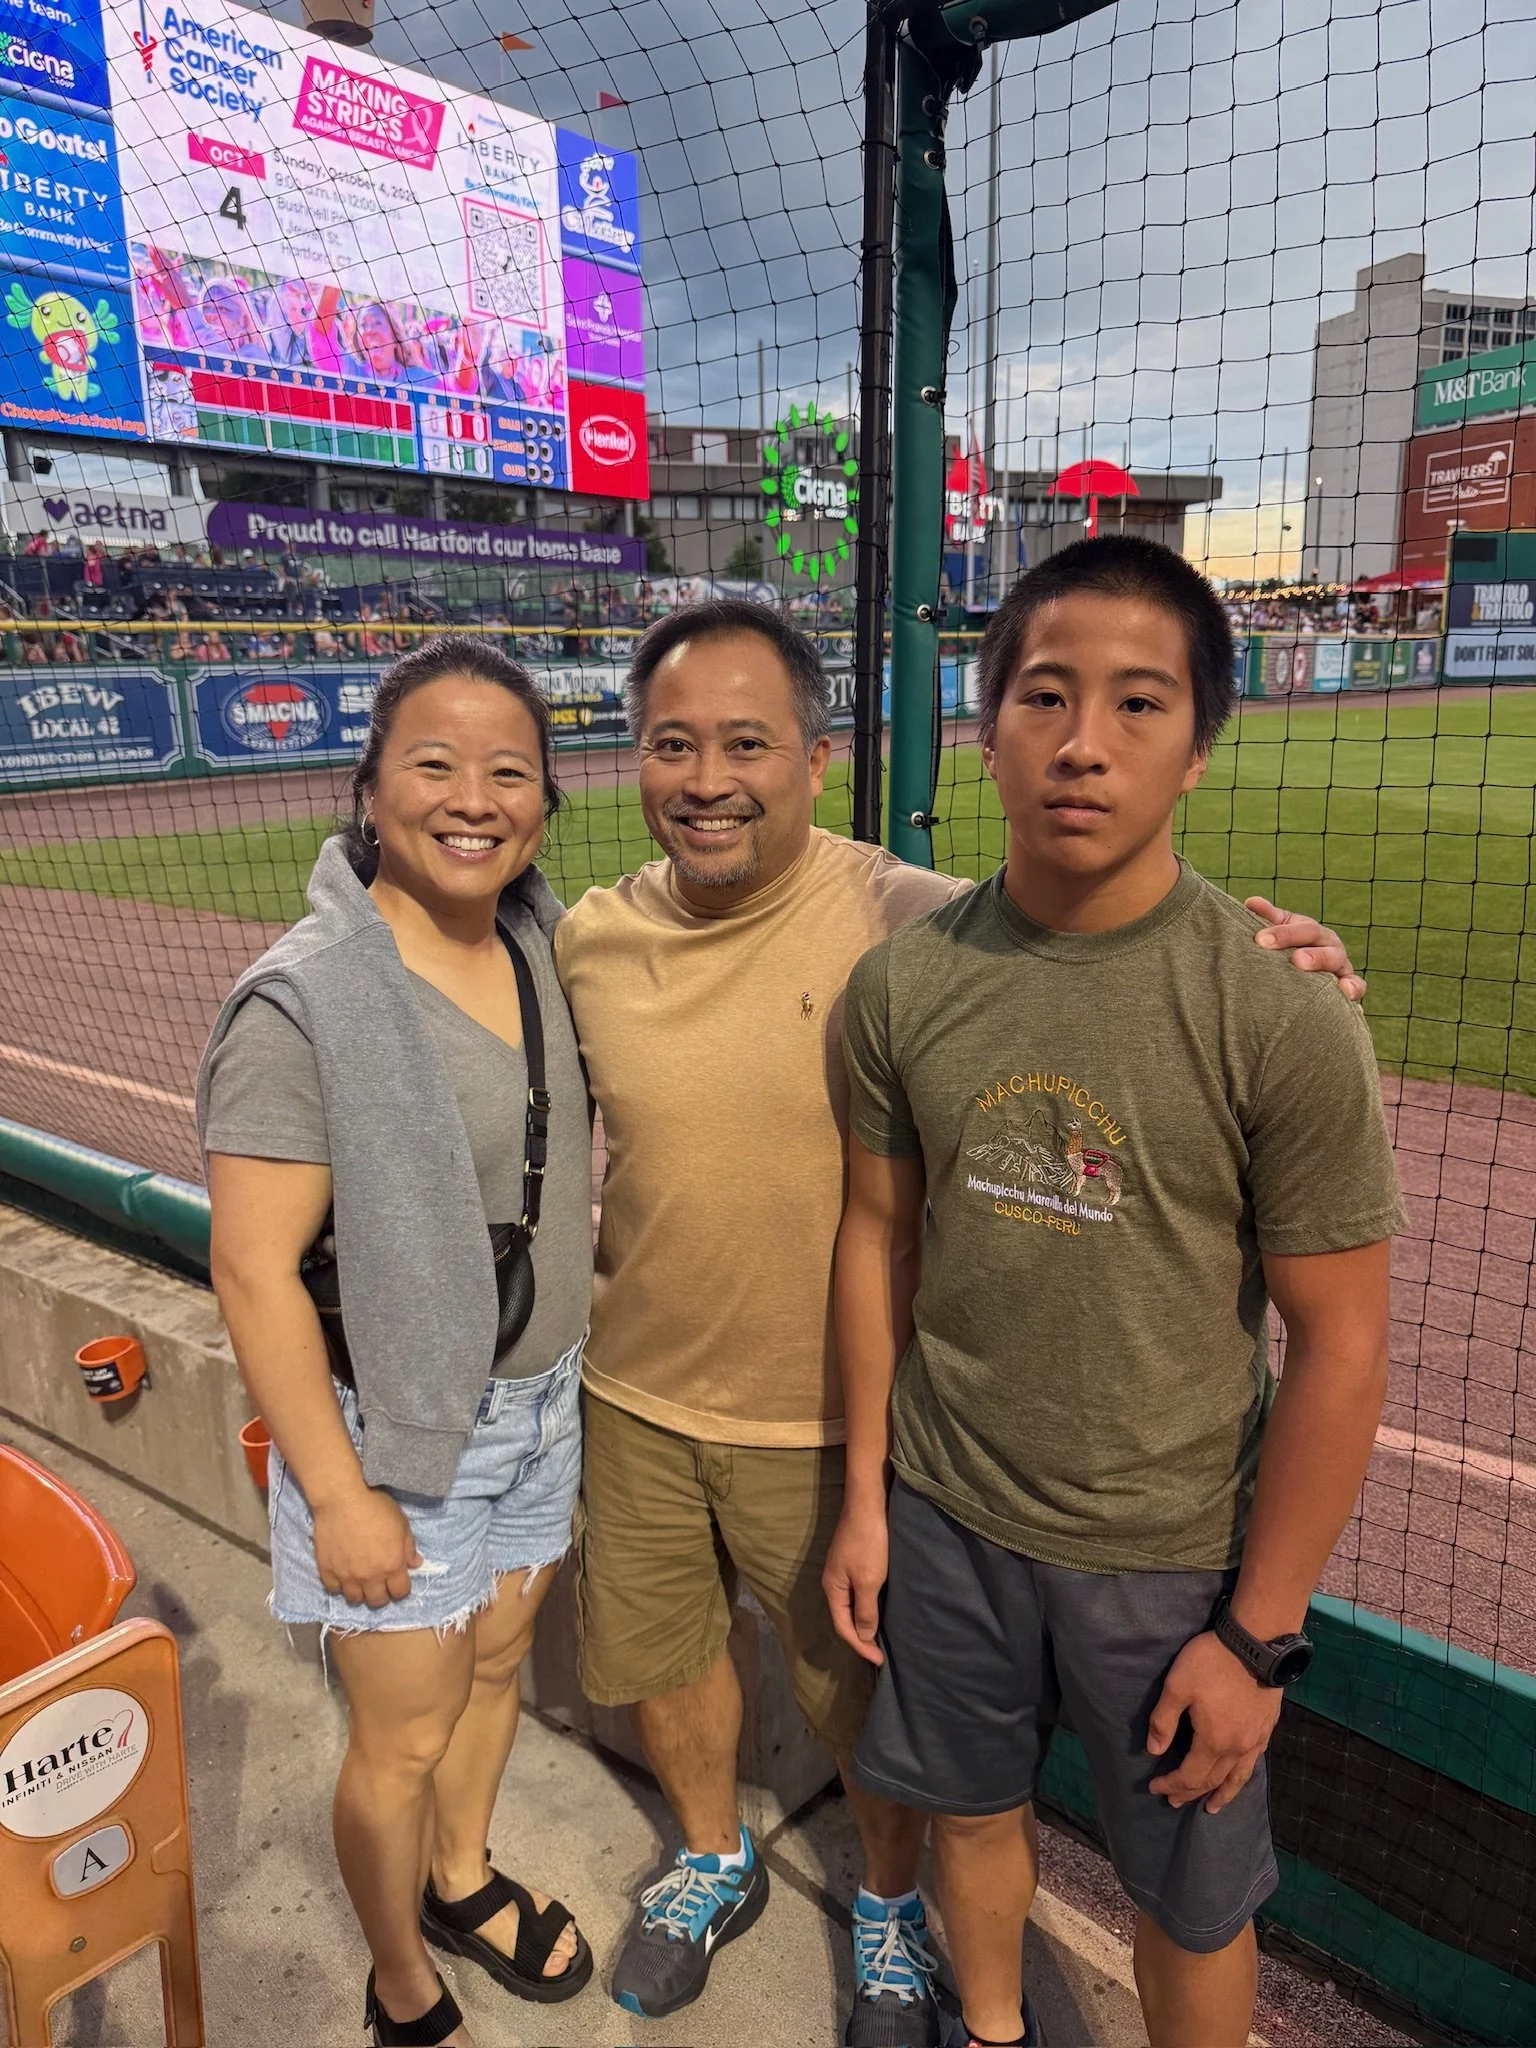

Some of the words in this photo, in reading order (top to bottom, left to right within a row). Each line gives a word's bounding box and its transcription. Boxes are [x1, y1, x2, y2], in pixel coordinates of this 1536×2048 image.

[28, 0, 78, 27] team.
[163, 6, 283, 71] American
[164, 37, 257, 89] Cancer
[312, 64, 408, 119] MAKING
[306, 91, 404, 142] STRIDES
[15, 116, 109, 164] Goats!
[210, 145, 245, 169] OCT
[273, 150, 326, 178] Sunday,
[0, 167, 108, 212] IBERTY
[219, 185, 247, 230] 4
[24, 201, 75, 226] BANK
[223, 360, 233, 374] 2
[1430, 461, 1493, 486] TRAVELERS
[74, 502, 168, 532] aetna
[248, 513, 327, 545] Proud
[328, 520, 355, 546] to
[357, 522, 400, 549] call
[401, 524, 492, 557] Hartford
[492, 536, 527, 559] our
[527, 534, 579, 563] home
[580, 538, 622, 565] base
[17, 681, 125, 719] IBEW
[232, 700, 320, 726] SMACNA
[30, 717, 95, 740] LOCAL
[97, 715, 121, 736] 42
[975, 1071, 1127, 1146] MACHUPICCHU
[967, 1174, 1025, 1202] Machupicchu
[1063, 1201, 1078, 1216] del
[1078, 1204, 1114, 1223] Mundo
[994, 1201, 1083, 1236] CUSCO-PERU
[2, 1777, 52, 1808] INFINITI
[56, 1772, 65, 1780] &
[69, 1747, 113, 1774] NISSAN
[4, 1726, 114, 1796] Harte
[56, 1771, 83, 1790] DRIVE
[84, 1757, 108, 1775] WITH
[108, 1743, 138, 1764] HARTE
[79, 1846, 110, 1884] A
